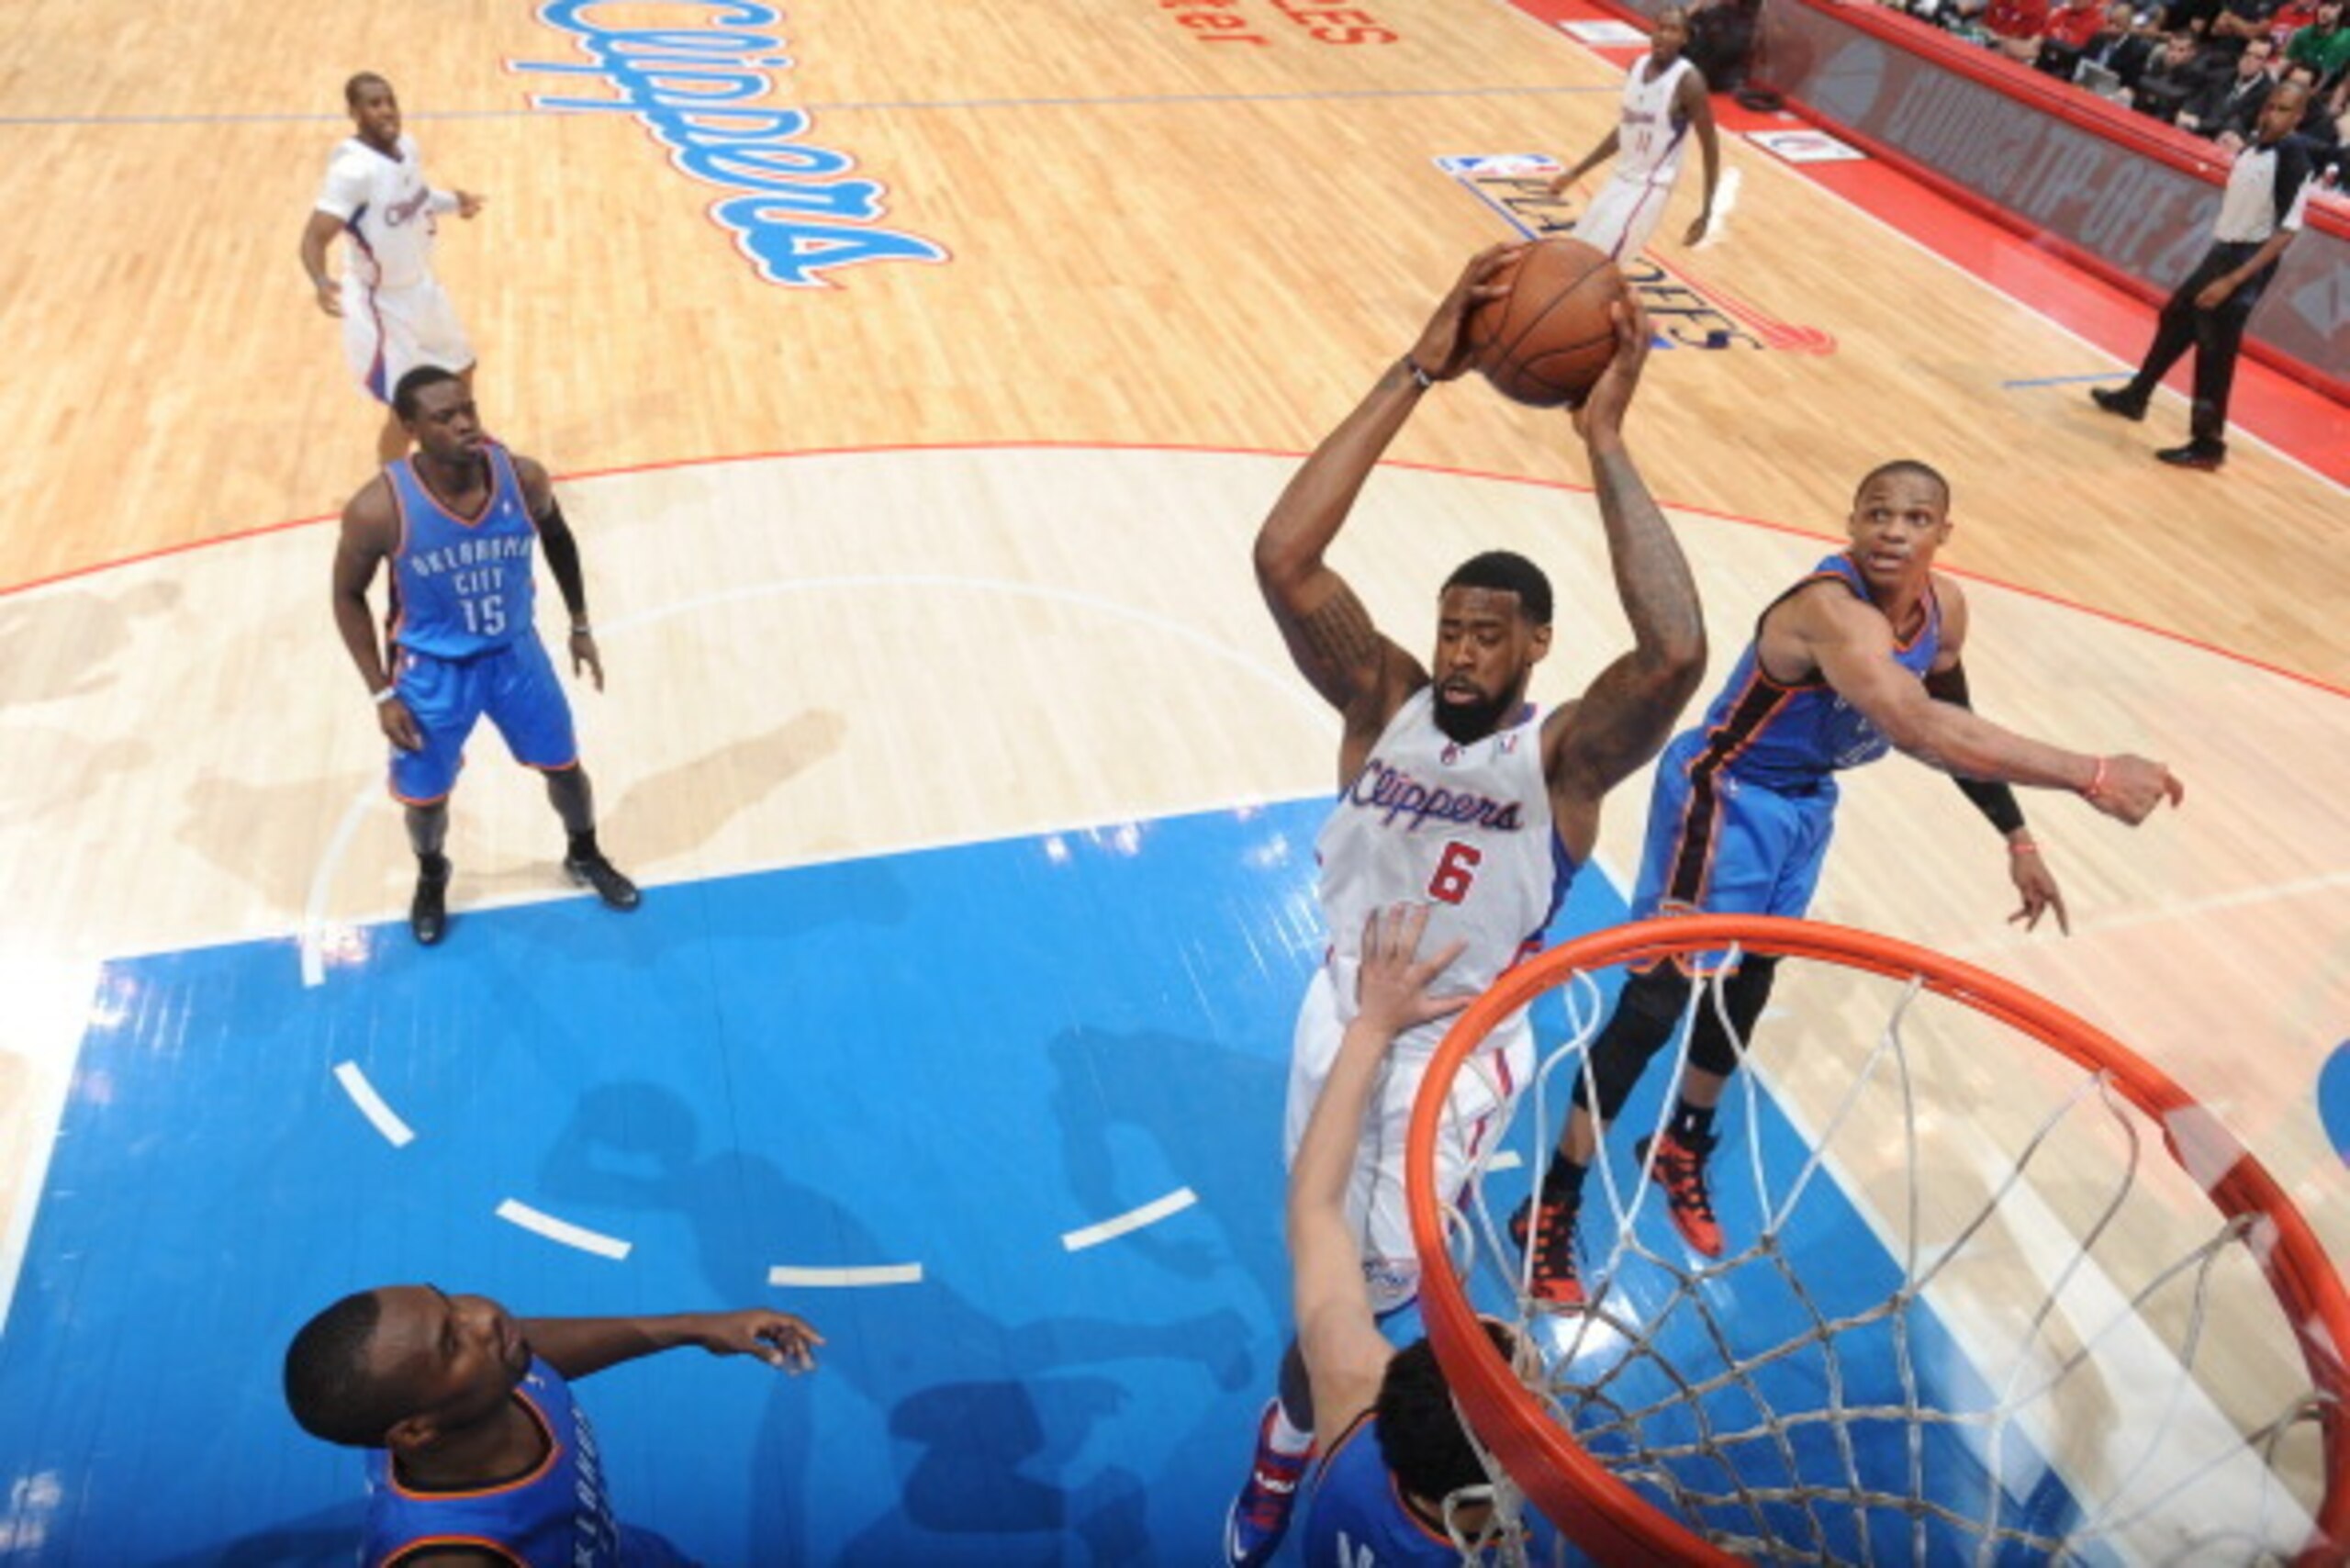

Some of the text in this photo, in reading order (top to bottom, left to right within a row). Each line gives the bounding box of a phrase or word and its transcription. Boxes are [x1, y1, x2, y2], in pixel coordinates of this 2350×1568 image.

[501, 0, 951, 289] Clippers
[454, 566, 503, 595] CITY
[460, 595, 507, 636] 15
[1338, 758, 1524, 831] Clippers
[1427, 839, 1482, 905] 6
